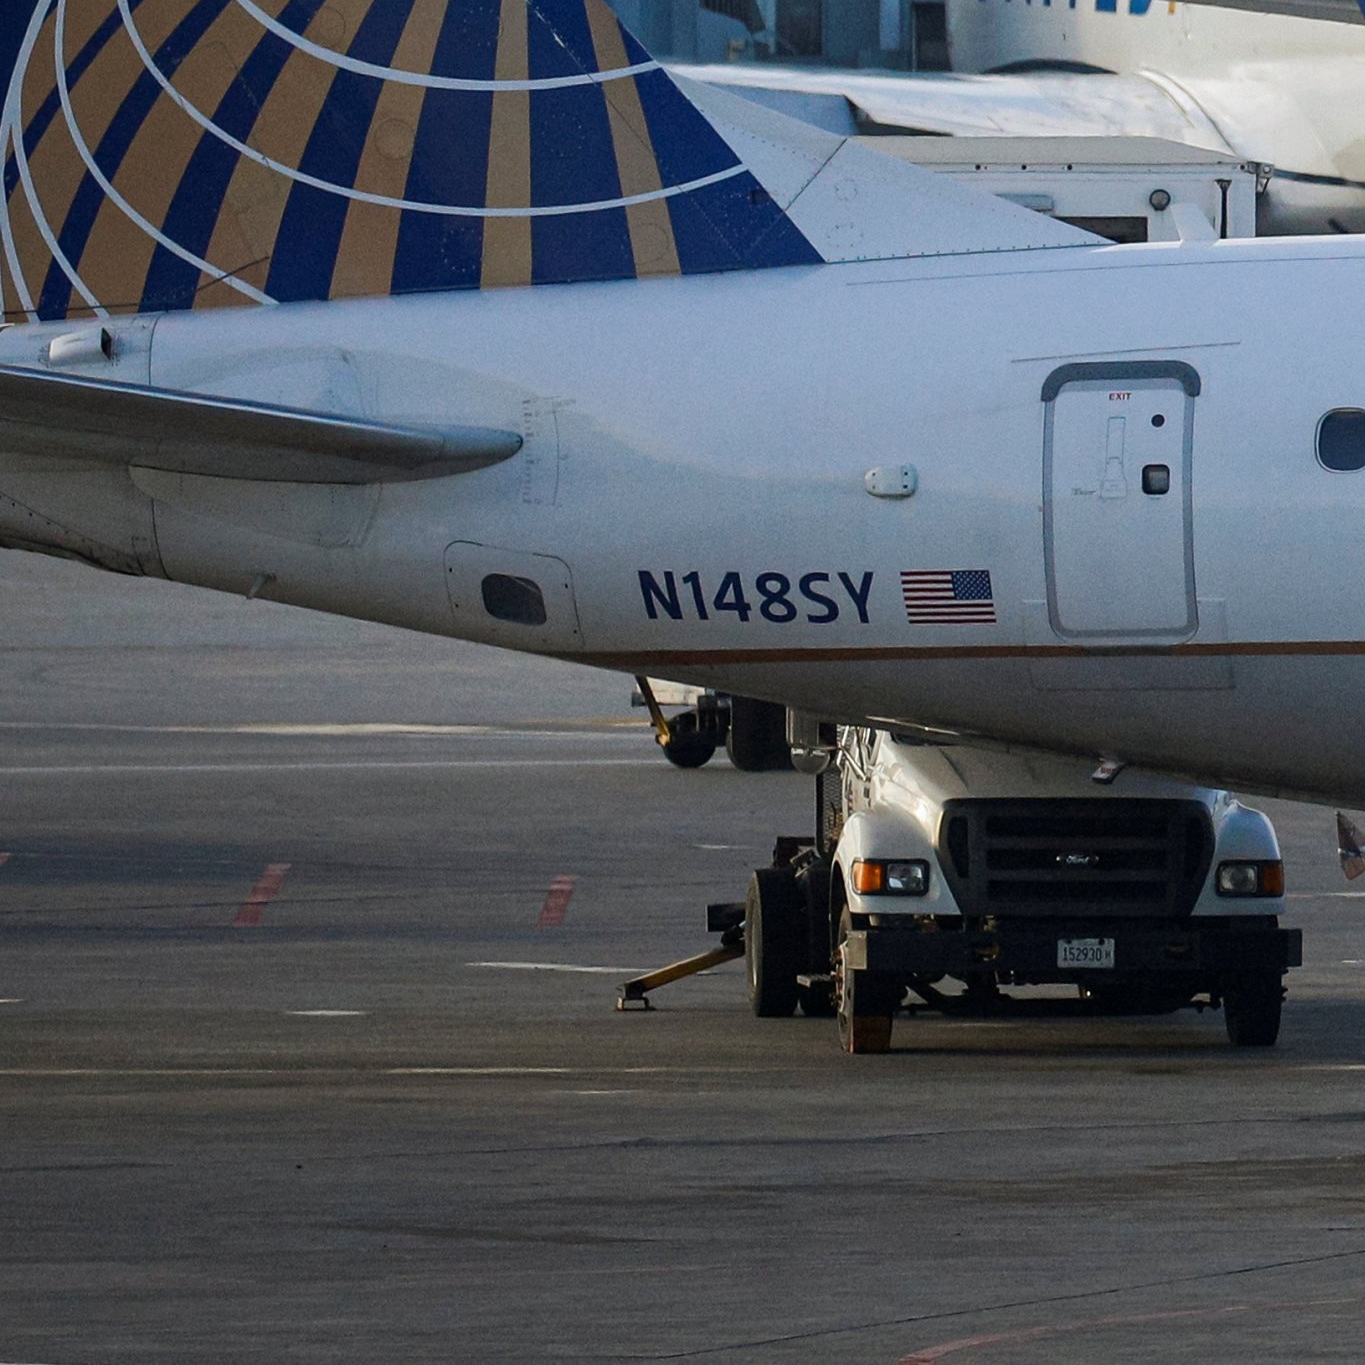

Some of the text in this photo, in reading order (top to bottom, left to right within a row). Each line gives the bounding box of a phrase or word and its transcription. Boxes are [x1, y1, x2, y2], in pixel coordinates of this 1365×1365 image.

[1109, 392, 1131, 401] EXIT
[638, 570, 874, 623] N148SY
[1063, 946, 1102, 962] 152930
